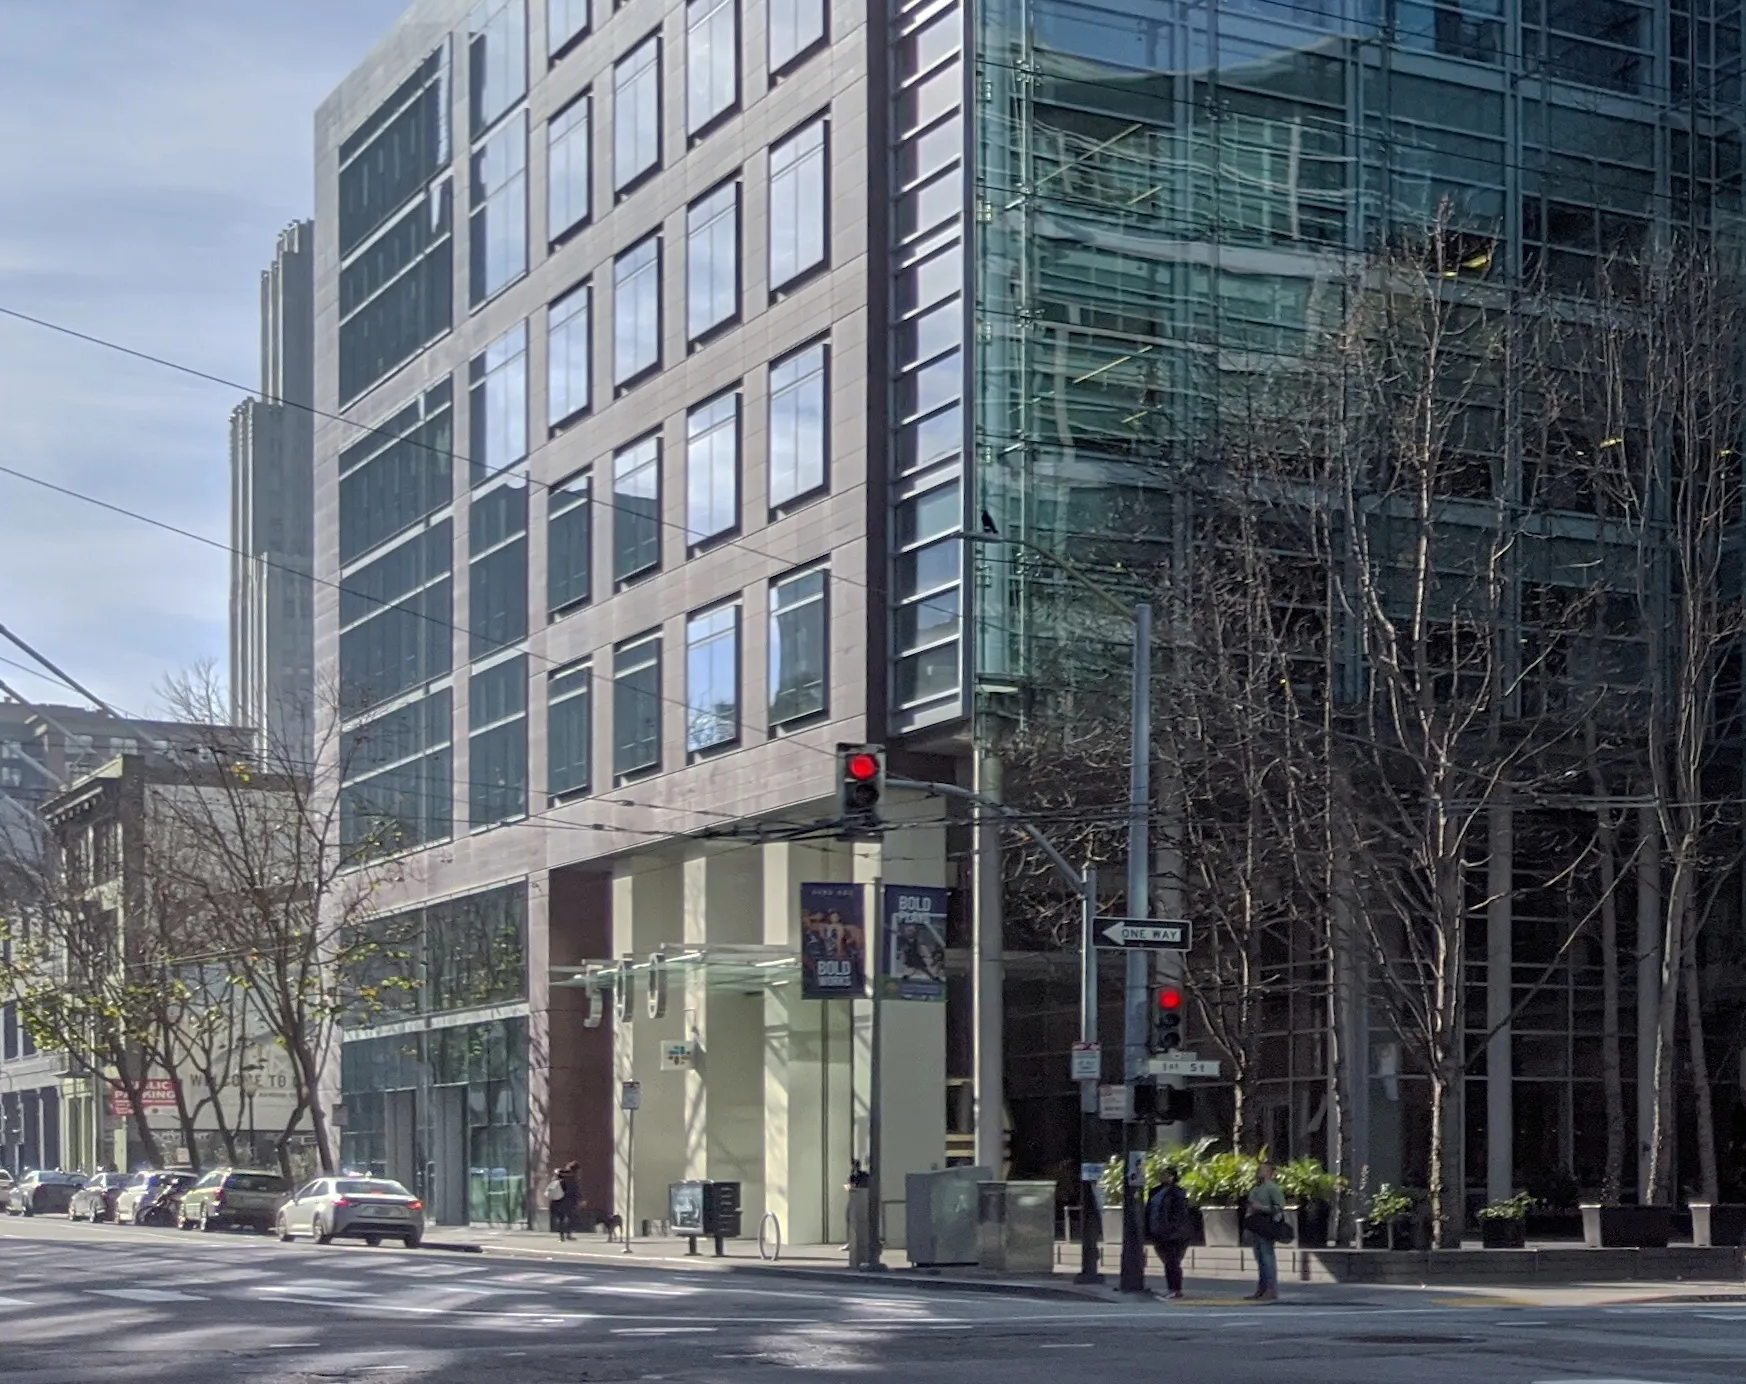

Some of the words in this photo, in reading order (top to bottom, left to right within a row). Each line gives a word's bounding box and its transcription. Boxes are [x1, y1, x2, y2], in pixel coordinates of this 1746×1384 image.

[899, 895, 932, 912] BOLD
[1121, 929, 1146, 939] ONE
[1152, 930, 1178, 940] WAY
[817, 961, 851, 975] BOLD
[114, 1090, 176, 1100] PAKING
